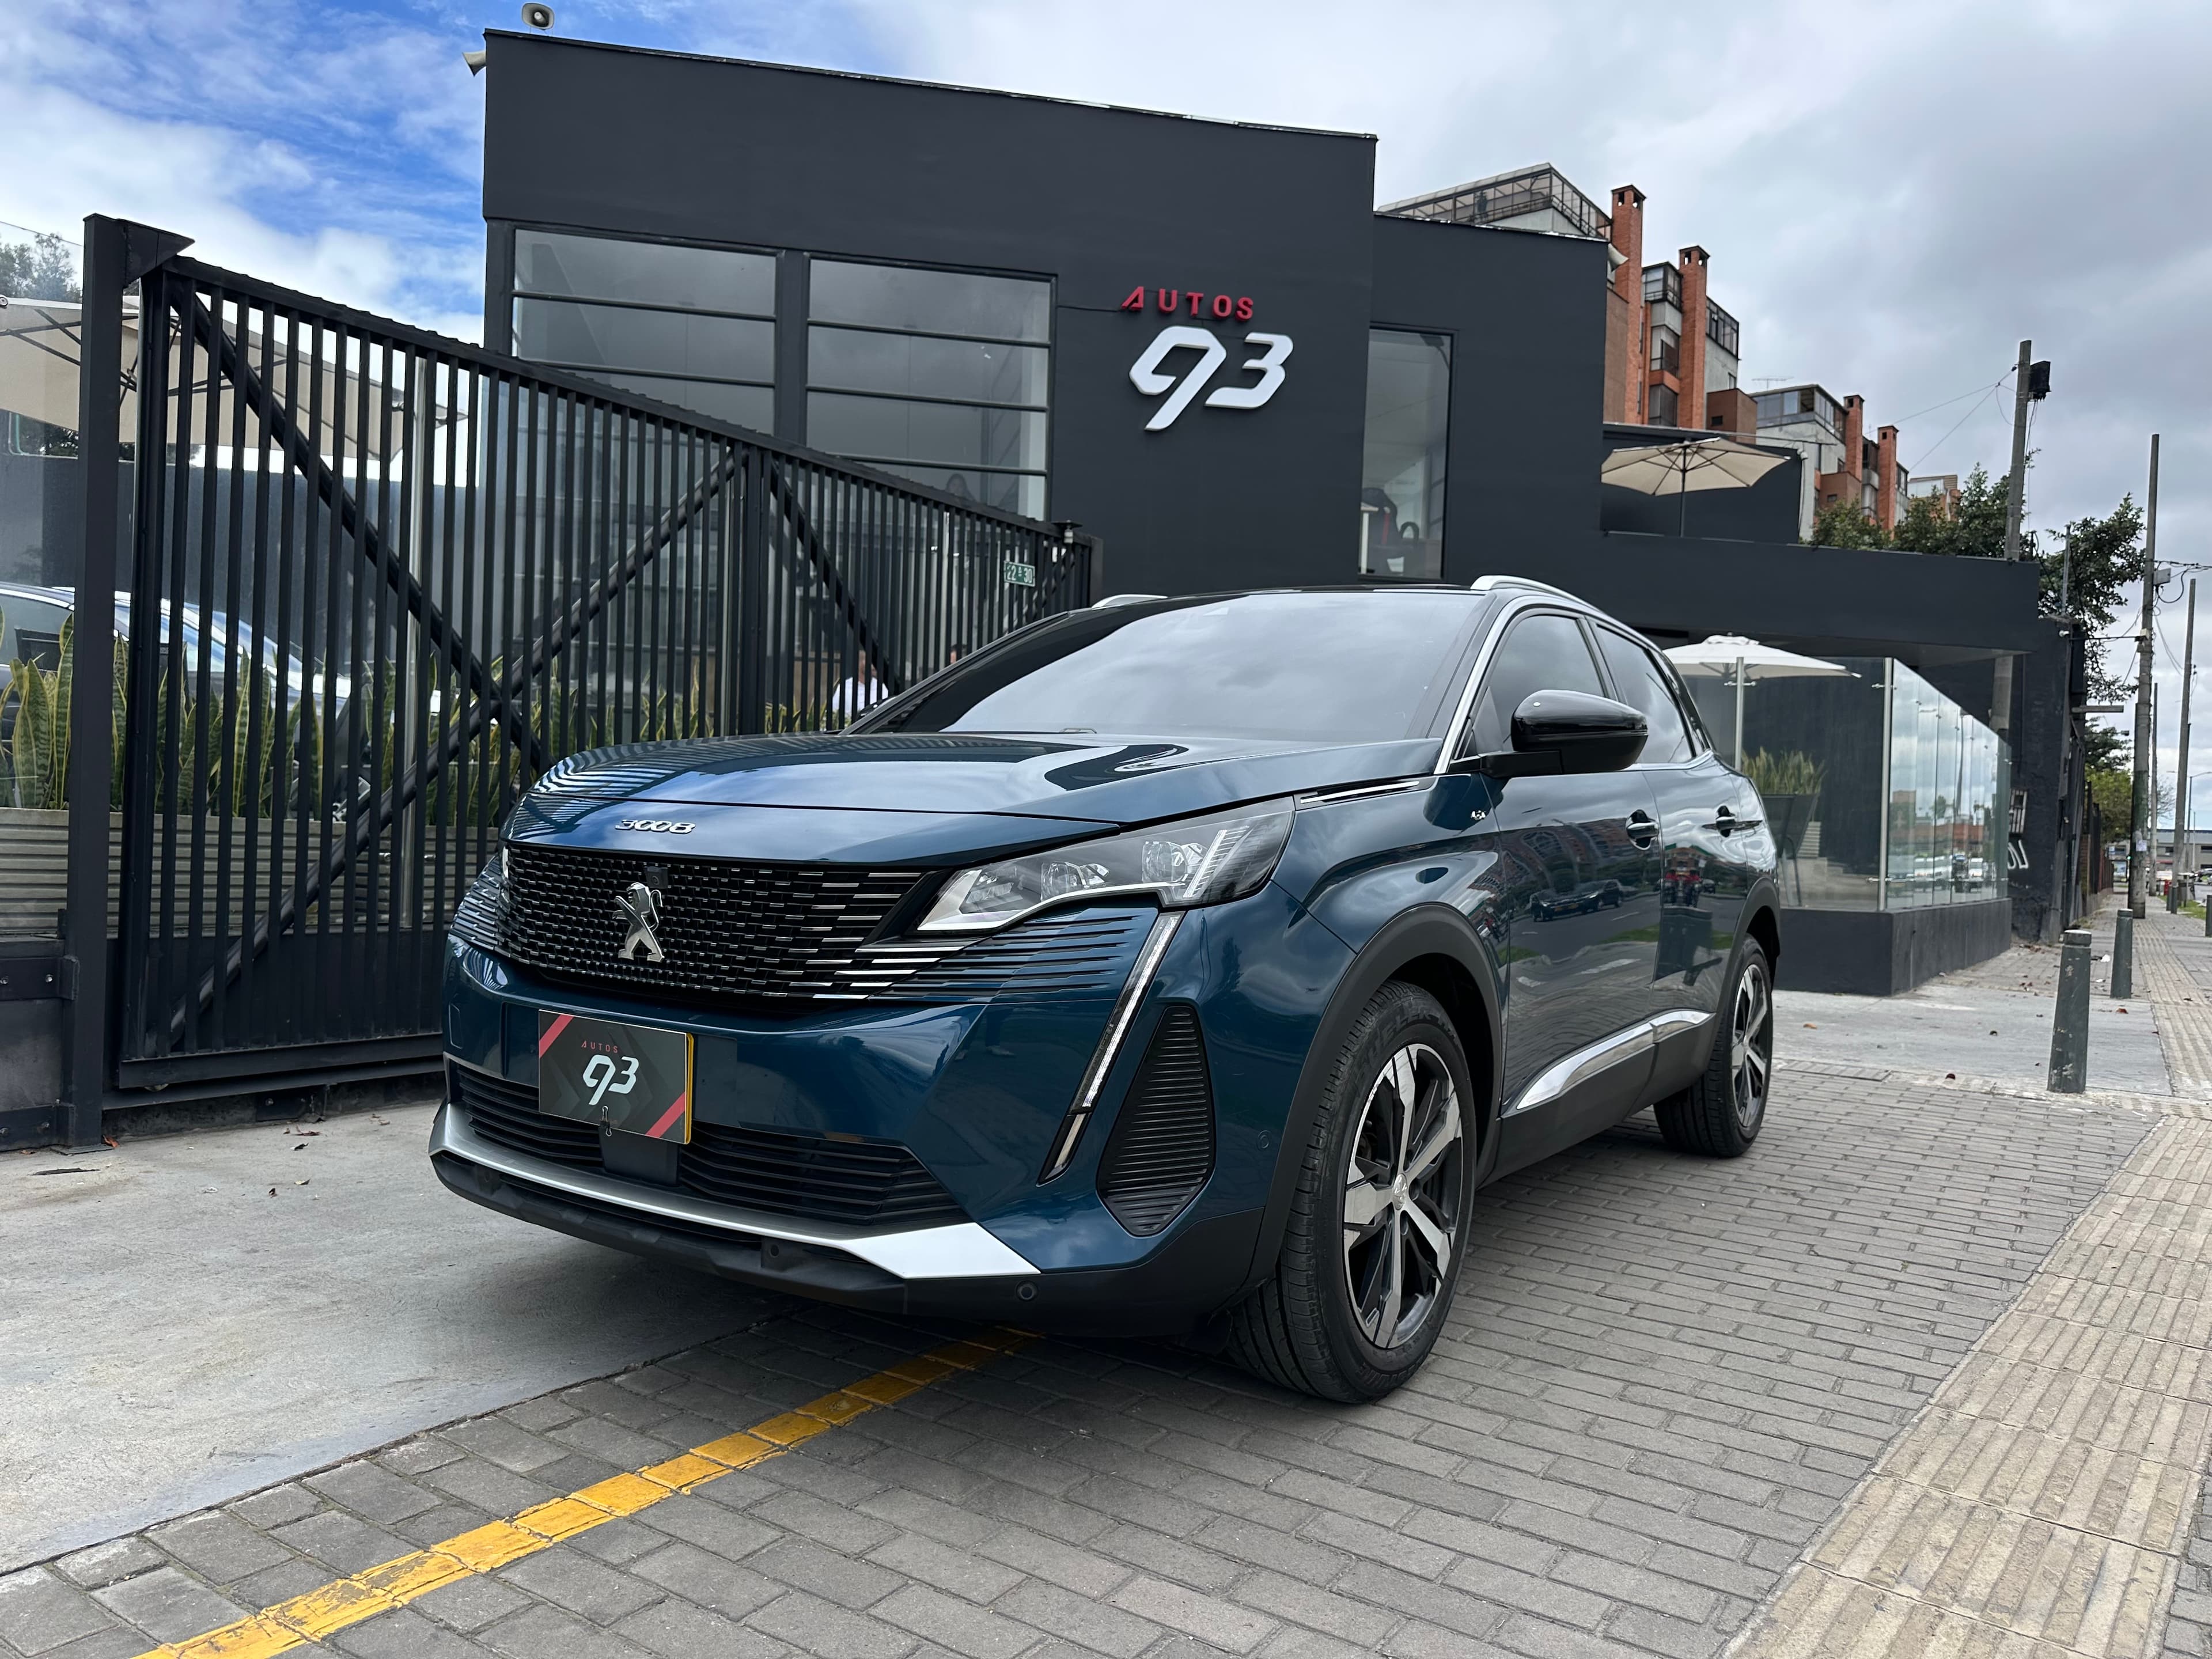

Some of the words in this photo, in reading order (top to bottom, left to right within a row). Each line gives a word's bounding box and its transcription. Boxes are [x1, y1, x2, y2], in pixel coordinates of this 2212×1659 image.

[1121, 286, 1254, 321] AUTOS
[1129, 325, 1294, 431] 93
[615, 819, 696, 834] 3008
[581, 1040, 618, 1054] AUTOS
[582, 1054, 639, 1105] 93
